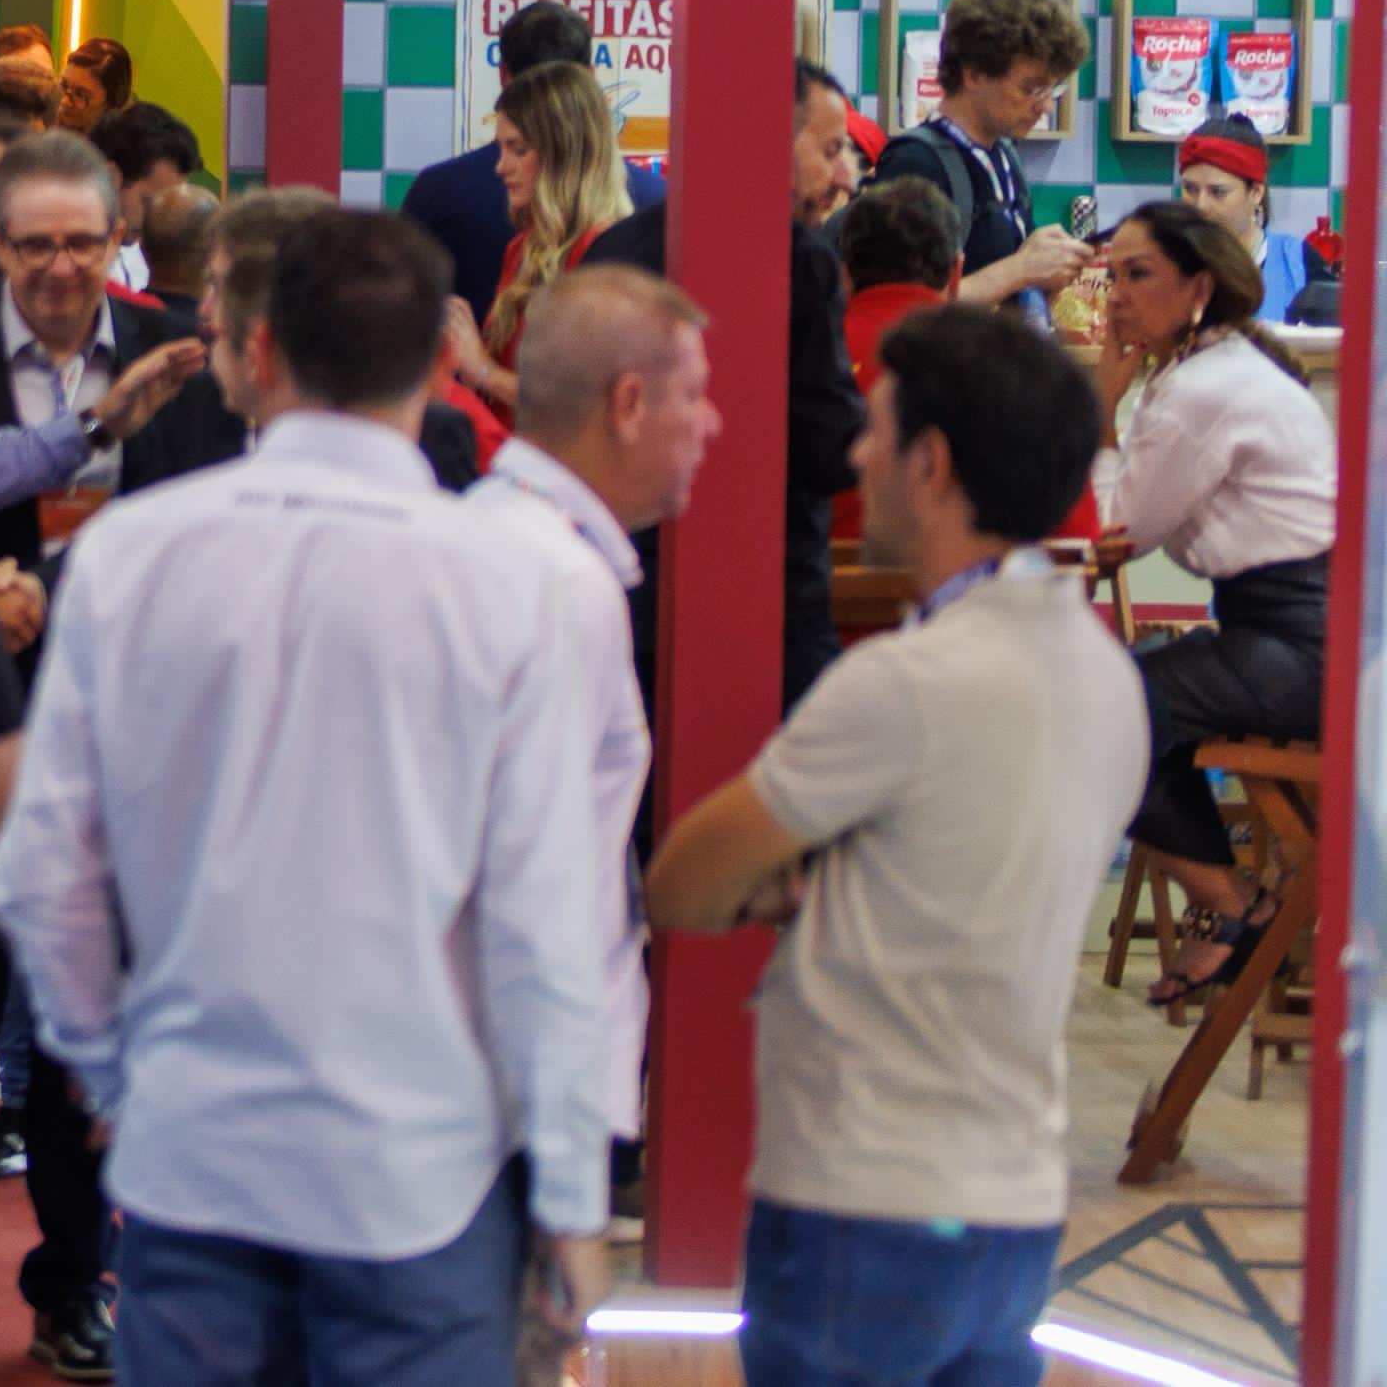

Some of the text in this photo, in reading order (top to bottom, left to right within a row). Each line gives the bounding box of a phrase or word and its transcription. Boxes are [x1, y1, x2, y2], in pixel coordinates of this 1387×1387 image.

[1142, 34, 1202, 54] Rocha
[624, 44, 673, 73] AQ
[1234, 48, 1287, 65] Rocha
